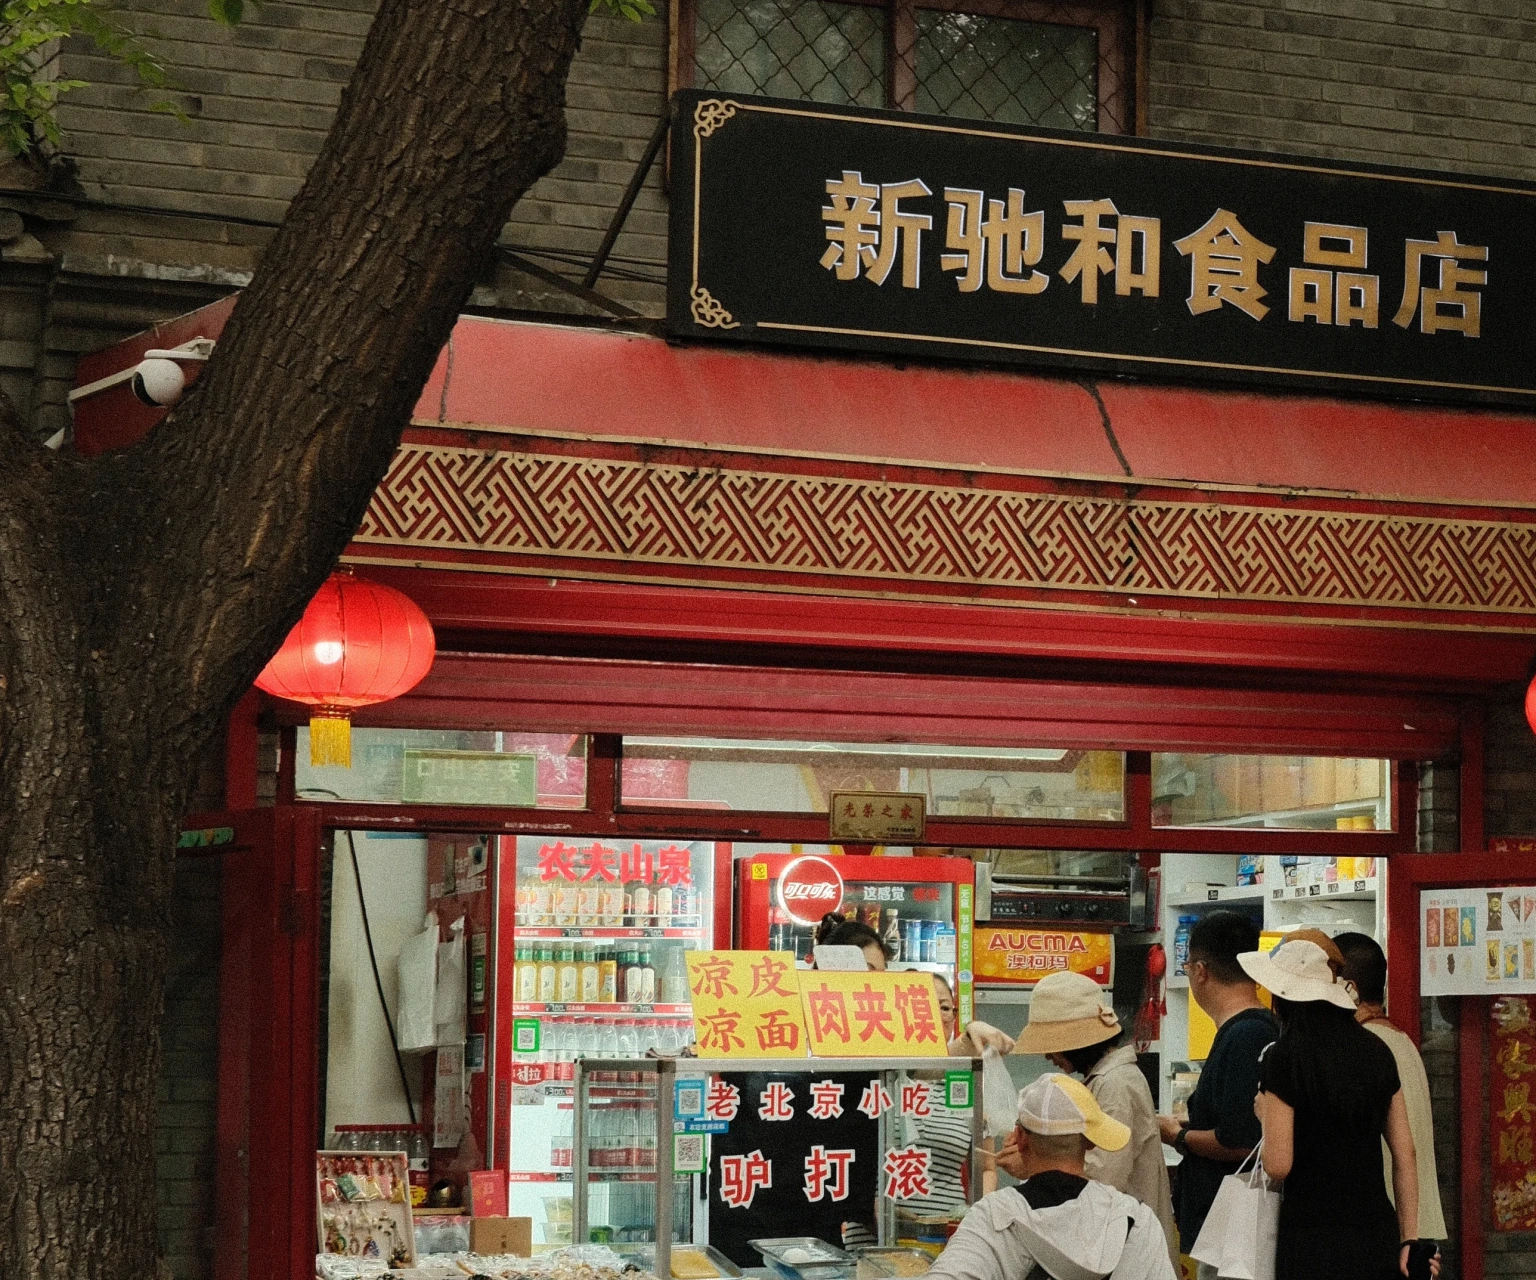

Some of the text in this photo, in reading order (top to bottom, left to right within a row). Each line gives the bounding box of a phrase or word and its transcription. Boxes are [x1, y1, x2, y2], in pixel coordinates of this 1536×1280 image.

[819, 169, 1490, 339] 新驰和食品店
[843, 802, 915, 819] 光荣之家
[537, 841, 692, 885] 农夫山泉
[864, 886, 905, 901] 这感觉
[988, 933, 1088, 952] AUCMA
[1007, 954, 1069, 970] 澳柯玛
[691, 955, 798, 999] 凉皮
[698, 1007, 800, 1053] 凉面
[808, 982, 939, 1044] 肉夹馍
[706, 1080, 931, 1119] 老北京小吃
[721, 1146, 932, 1207] 驴打滚
